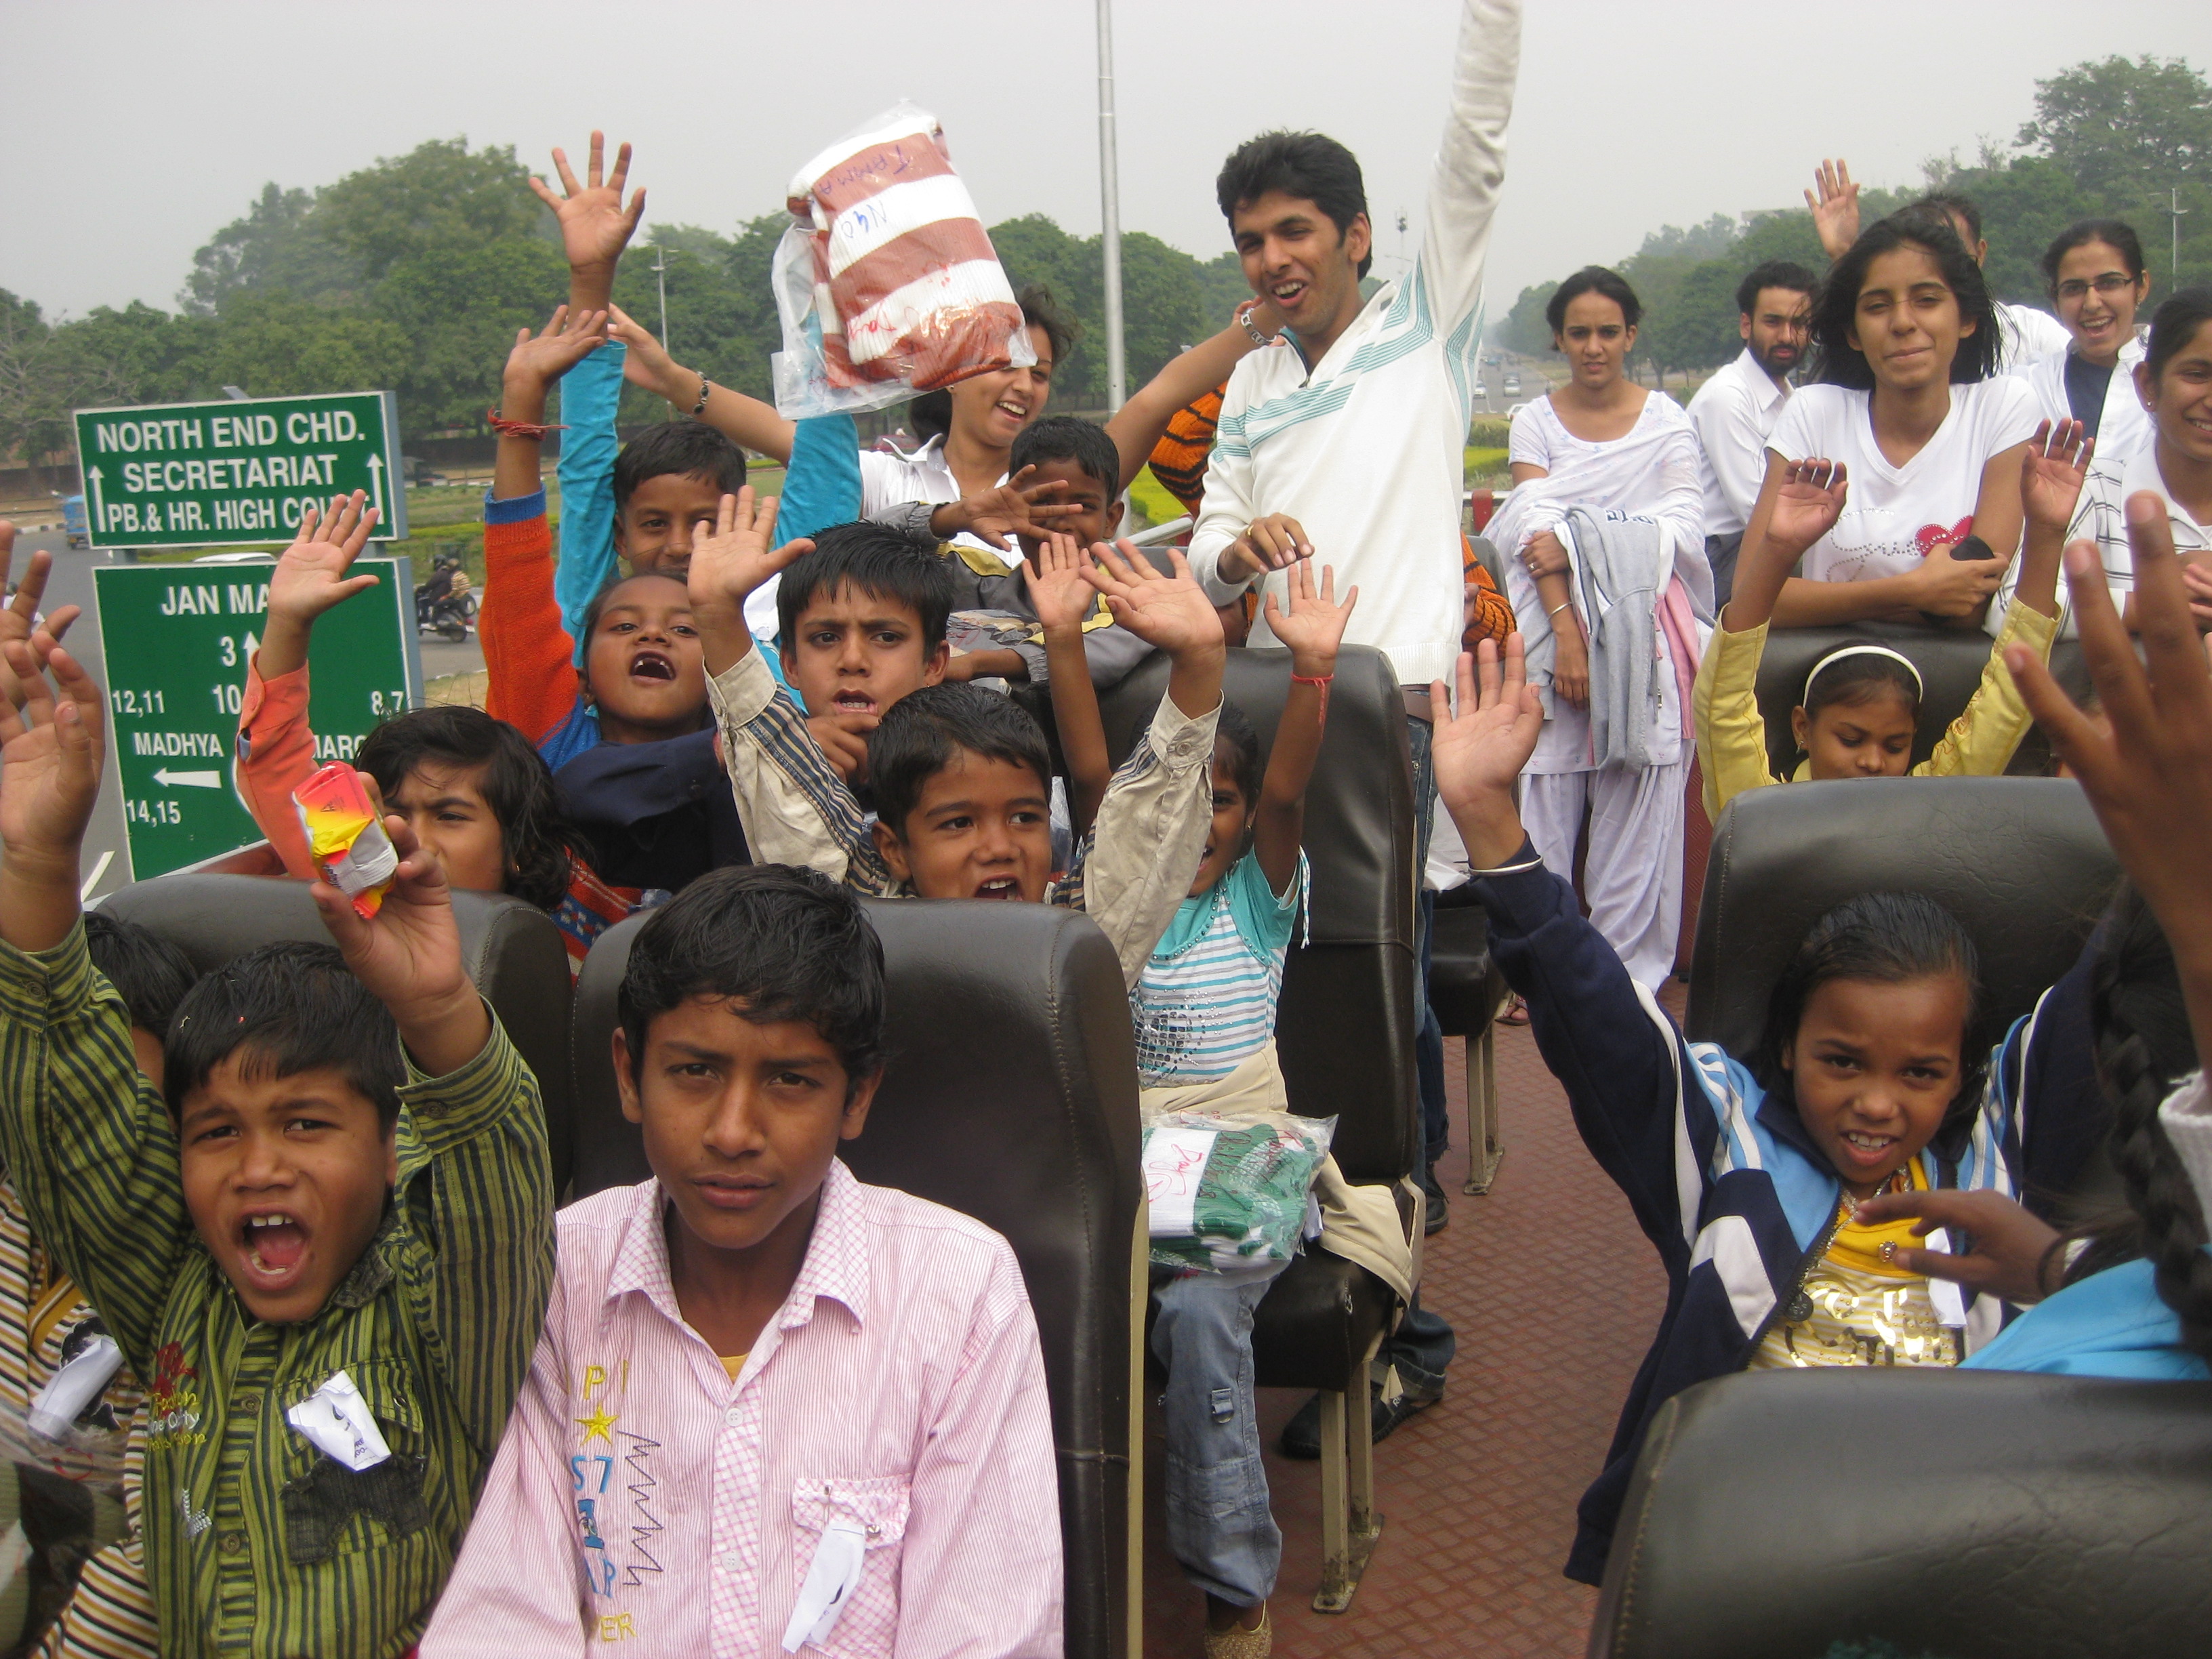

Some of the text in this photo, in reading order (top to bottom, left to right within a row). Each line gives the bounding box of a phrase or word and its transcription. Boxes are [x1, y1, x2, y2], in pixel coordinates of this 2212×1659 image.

[96, 410, 366, 453] NORTH END CHD.
[123, 454, 339, 493] SECRETARIAT
[168, 501, 209, 533] HR.
[215, 498, 276, 531] HIGH
[161, 583, 270, 615] JAN MA
[220, 636, 237, 667] 3
[112, 691, 165, 720] 12,11
[211, 684, 242, 714] 10
[371, 690, 405, 720] 8,7
[134, 733, 224, 758] MADHYA
[127, 800, 182, 826] 14,15
[1149, 1143, 1205, 1195] Day
